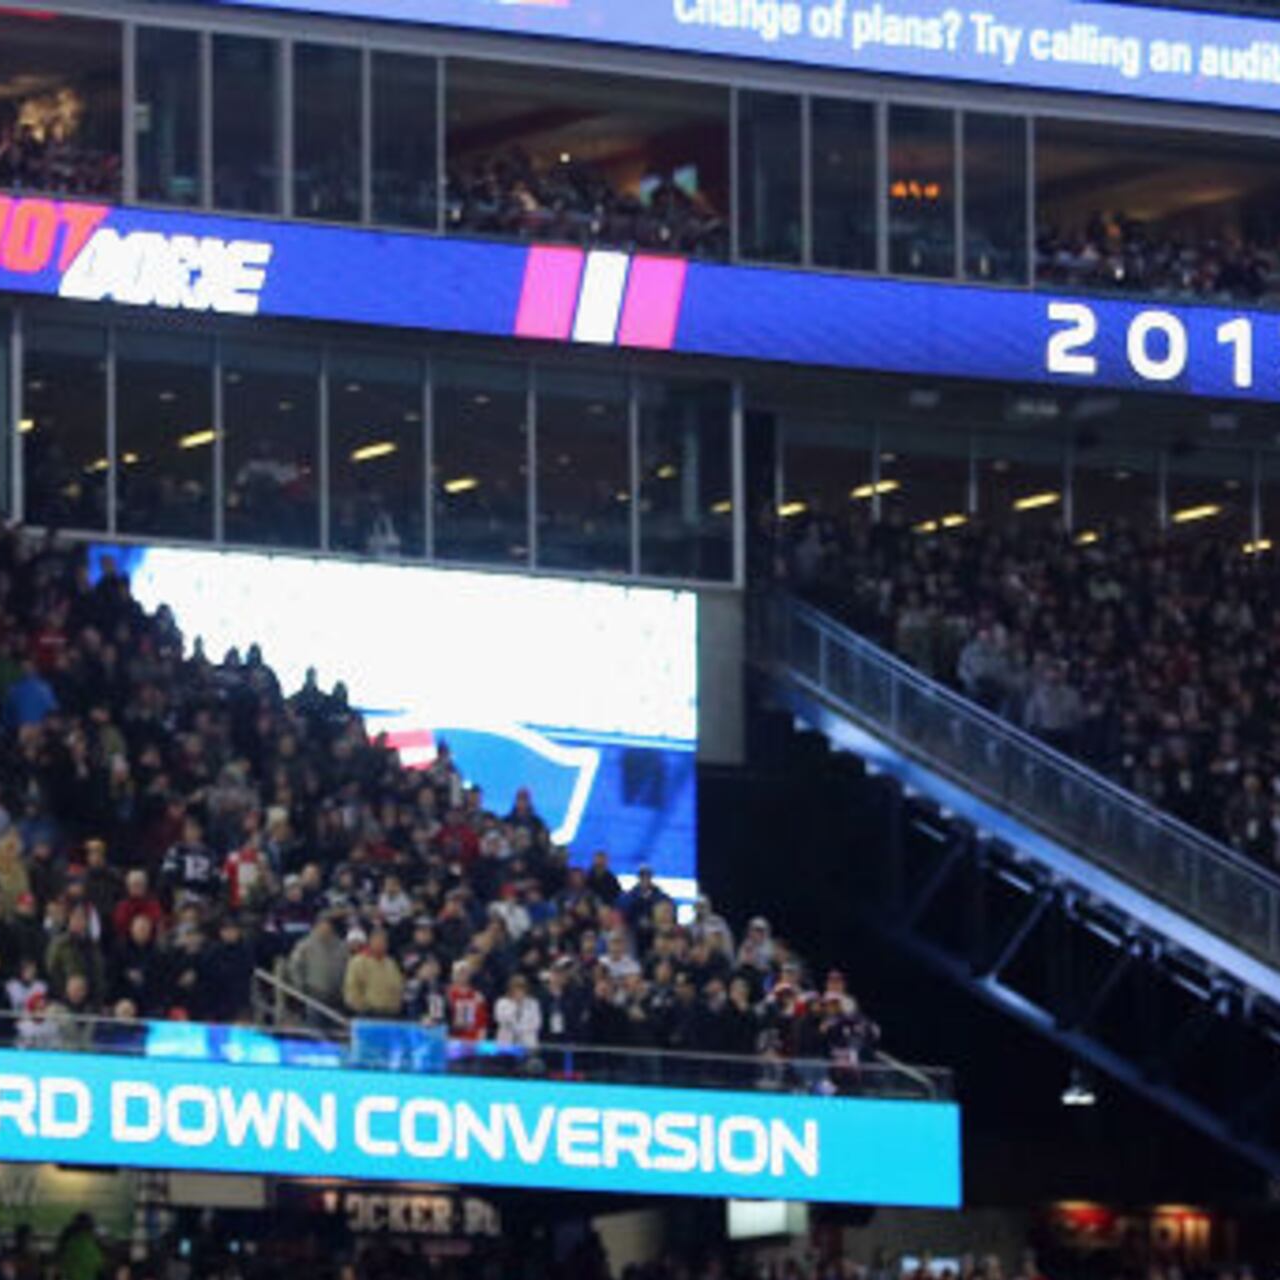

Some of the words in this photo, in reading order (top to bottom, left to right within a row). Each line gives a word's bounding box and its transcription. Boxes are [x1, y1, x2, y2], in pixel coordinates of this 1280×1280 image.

[809, 0, 846, 38] of
[851, 3, 962, 50] plans?
[968, 13, 1021, 65] Try
[1029, 22, 1141, 77] calling
[1149, 39, 1192, 72] an
[110, 1081, 337, 1153] DOWN
[354, 1094, 818, 1177] CONVERSION
